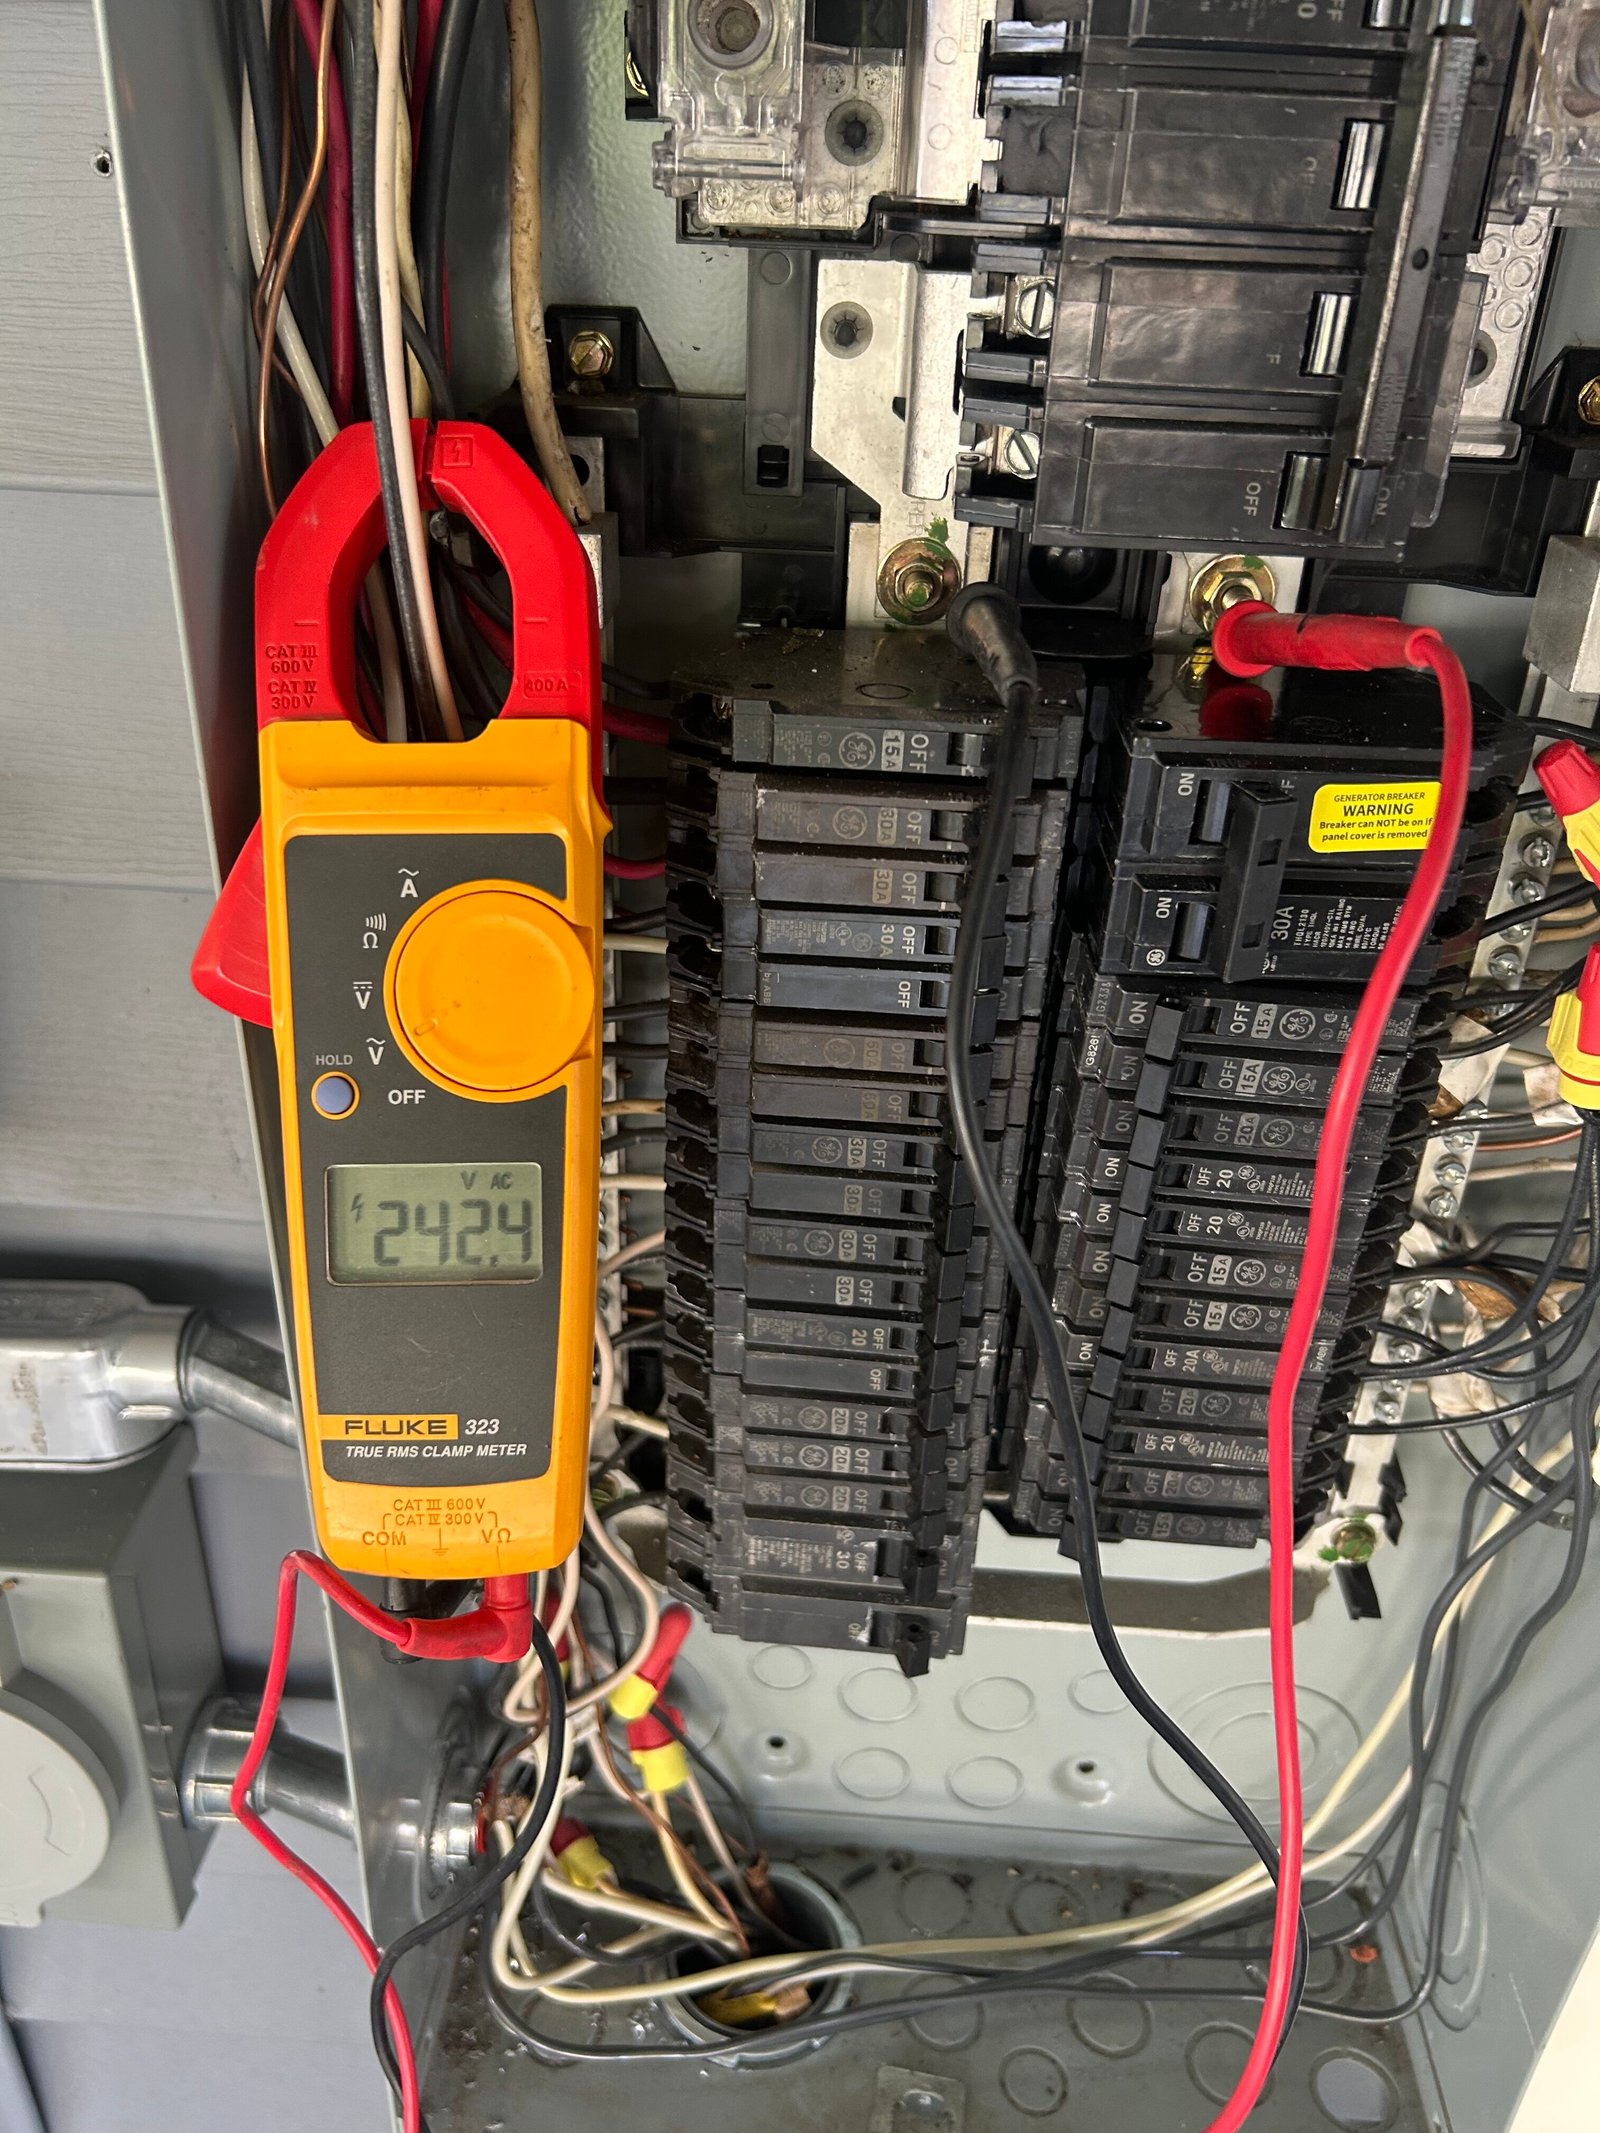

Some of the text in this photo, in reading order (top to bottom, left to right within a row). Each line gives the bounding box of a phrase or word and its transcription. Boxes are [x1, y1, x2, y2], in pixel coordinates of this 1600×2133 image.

[1242, 481, 1262, 517] OFF
[265, 644, 319, 659] CAT III
[271, 659, 314, 673] 600 V
[268, 679, 317, 694] CAT IV
[271, 695, 314, 709] 300 V
[910, 734, 929, 773] OFF
[1178, 772, 1195, 796] ON
[1334, 792, 1425, 802] GENERATOR BREAKER
[1343, 803, 1414, 817] WARNING
[880, 808, 895, 842] 30A
[907, 811, 922, 845] OFF
[1319, 821, 1356, 829] Breaker
[1376, 819, 1396, 827] NOT
[1398, 819, 1410, 827] be
[1322, 832, 1348, 842] panel
[1378, 831, 1385, 839] is
[1386, 830, 1428, 839] removed
[400, 879, 418, 897] A
[876, 870, 890, 902] 30A
[901, 872, 917, 904] OFF
[1156, 897, 1172, 919] ON
[1271, 906, 1295, 940] 30A
[880, 924, 894, 957] 30A
[901, 926, 915, 955] OFF
[898, 980, 911, 1009] OFF
[1128, 1001, 1148, 1024] ON
[1230, 1002, 1251, 1034] OFF
[315, 1054, 353, 1066] HOLD
[1121, 1055, 1138, 1077] ON
[1218, 1060, 1237, 1089] OFF
[1241, 1063, 1260, 1091] 15A
[388, 1090, 426, 1105] OFF
[1116, 1109, 1134, 1132] ON
[1214, 1113, 1234, 1142] OFF
[1238, 1117, 1256, 1143] 20A
[850, 1137, 864, 1166] 30A
[873, 1140, 887, 1168] OFF
[1104, 1157, 1120, 1177] ON
[1196, 1167, 1212, 1186] OFF
[461, 1172, 512, 1190] V AC
[1216, 1169, 1234, 1189] 20
[868, 1188, 883, 1216] OFF
[1096, 1203, 1112, 1223] ON
[374, 1199, 533, 1268] 242.4
[1187, 1213, 1202, 1232] OFF
[1206, 1216, 1224, 1235] 20
[863, 1234, 877, 1261] OFF
[1092, 1249, 1110, 1273] ON
[1187, 1253, 1208, 1283] OFF
[859, 1279, 873, 1305] OFF
[1089, 1296, 1107, 1319] ON
[1183, 1299, 1204, 1327] OFF
[852, 1329, 867, 1346] 20
[873, 1328, 885, 1350] OFF
[1079, 1342, 1094, 1360] ON
[1164, 1349, 1178, 1367] OFF
[1182, 1350, 1200, 1373] 20A
[870, 1369, 882, 1391] OFF
[1159, 1387, 1176, 1413] OFF
[345, 1419, 500, 1435] FLUKE 323
[854, 1411, 868, 1435] OFF
[346, 1443, 527, 1458] TRUE RMS CLAMP METER
[1145, 1433, 1158, 1451] OFF
[1161, 1435, 1176, 1451] 20
[855, 1448, 870, 1474] OFF
[1144, 1470, 1161, 1497] OFF
[394, 1499, 423, 1511] CAT
[446, 1499, 473, 1511] 600
[476, 1498, 486, 1510] V
[855, 1489, 868, 1512] OFF
[395, 1514, 424, 1526] CAT
[445, 1513, 472, 1525] 300
[474, 1513, 485, 1525] V
[1048, 1508, 1064, 1527] ON
[362, 1531, 406, 1546] COM
[481, 1530, 494, 1543] V
[836, 1551, 850, 1569] 30
